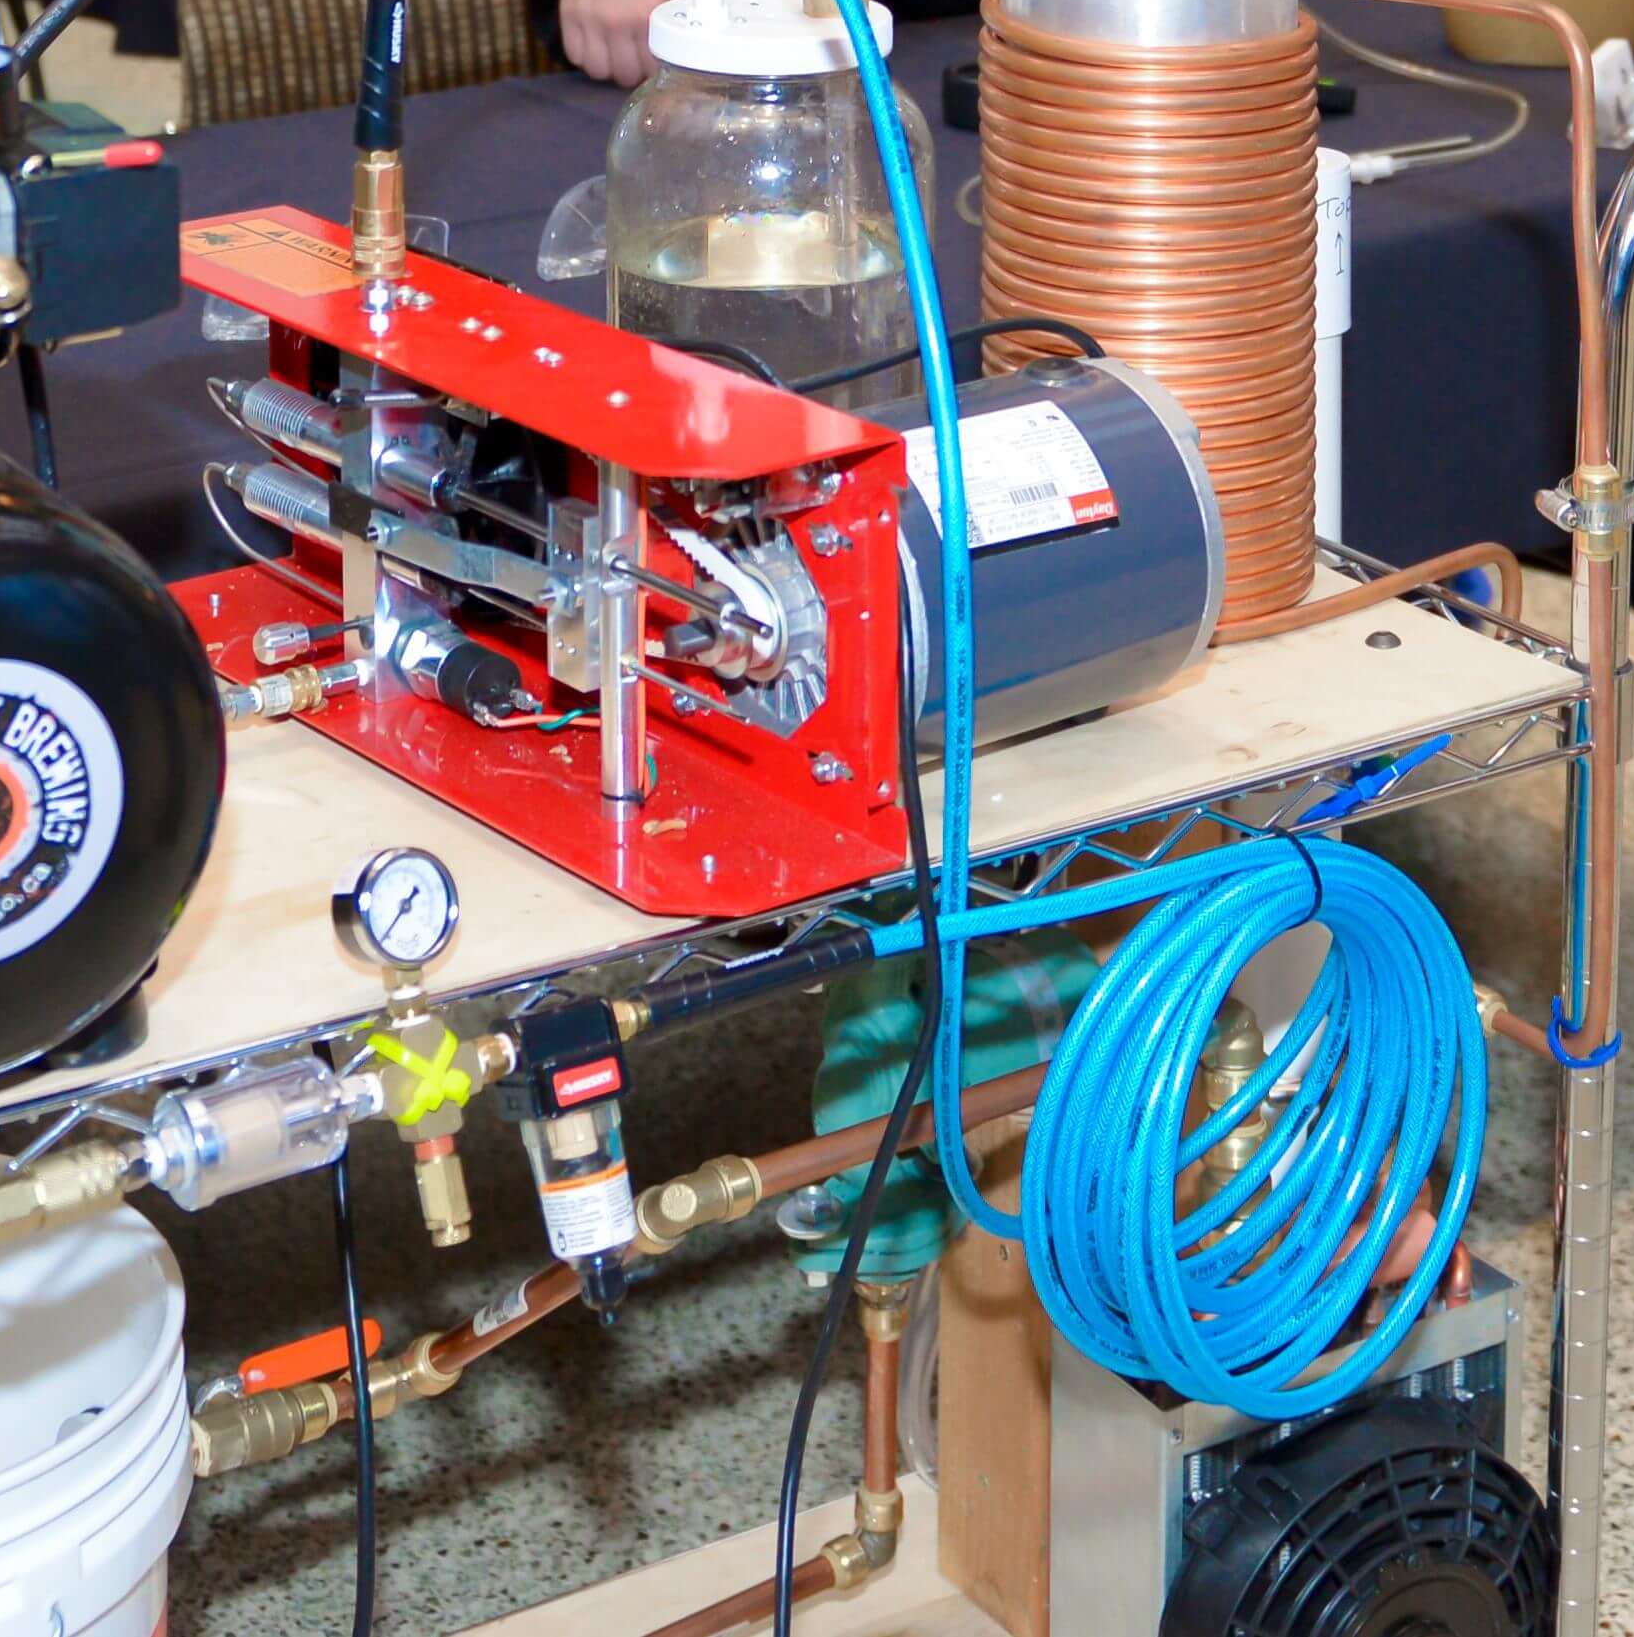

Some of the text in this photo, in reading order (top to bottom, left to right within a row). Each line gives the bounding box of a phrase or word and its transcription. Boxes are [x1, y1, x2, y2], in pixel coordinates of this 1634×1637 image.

[1075, 502, 1114, 521] Dayton
[3, 702, 88, 844] BREWING
[20, 862, 52, 894] ca
